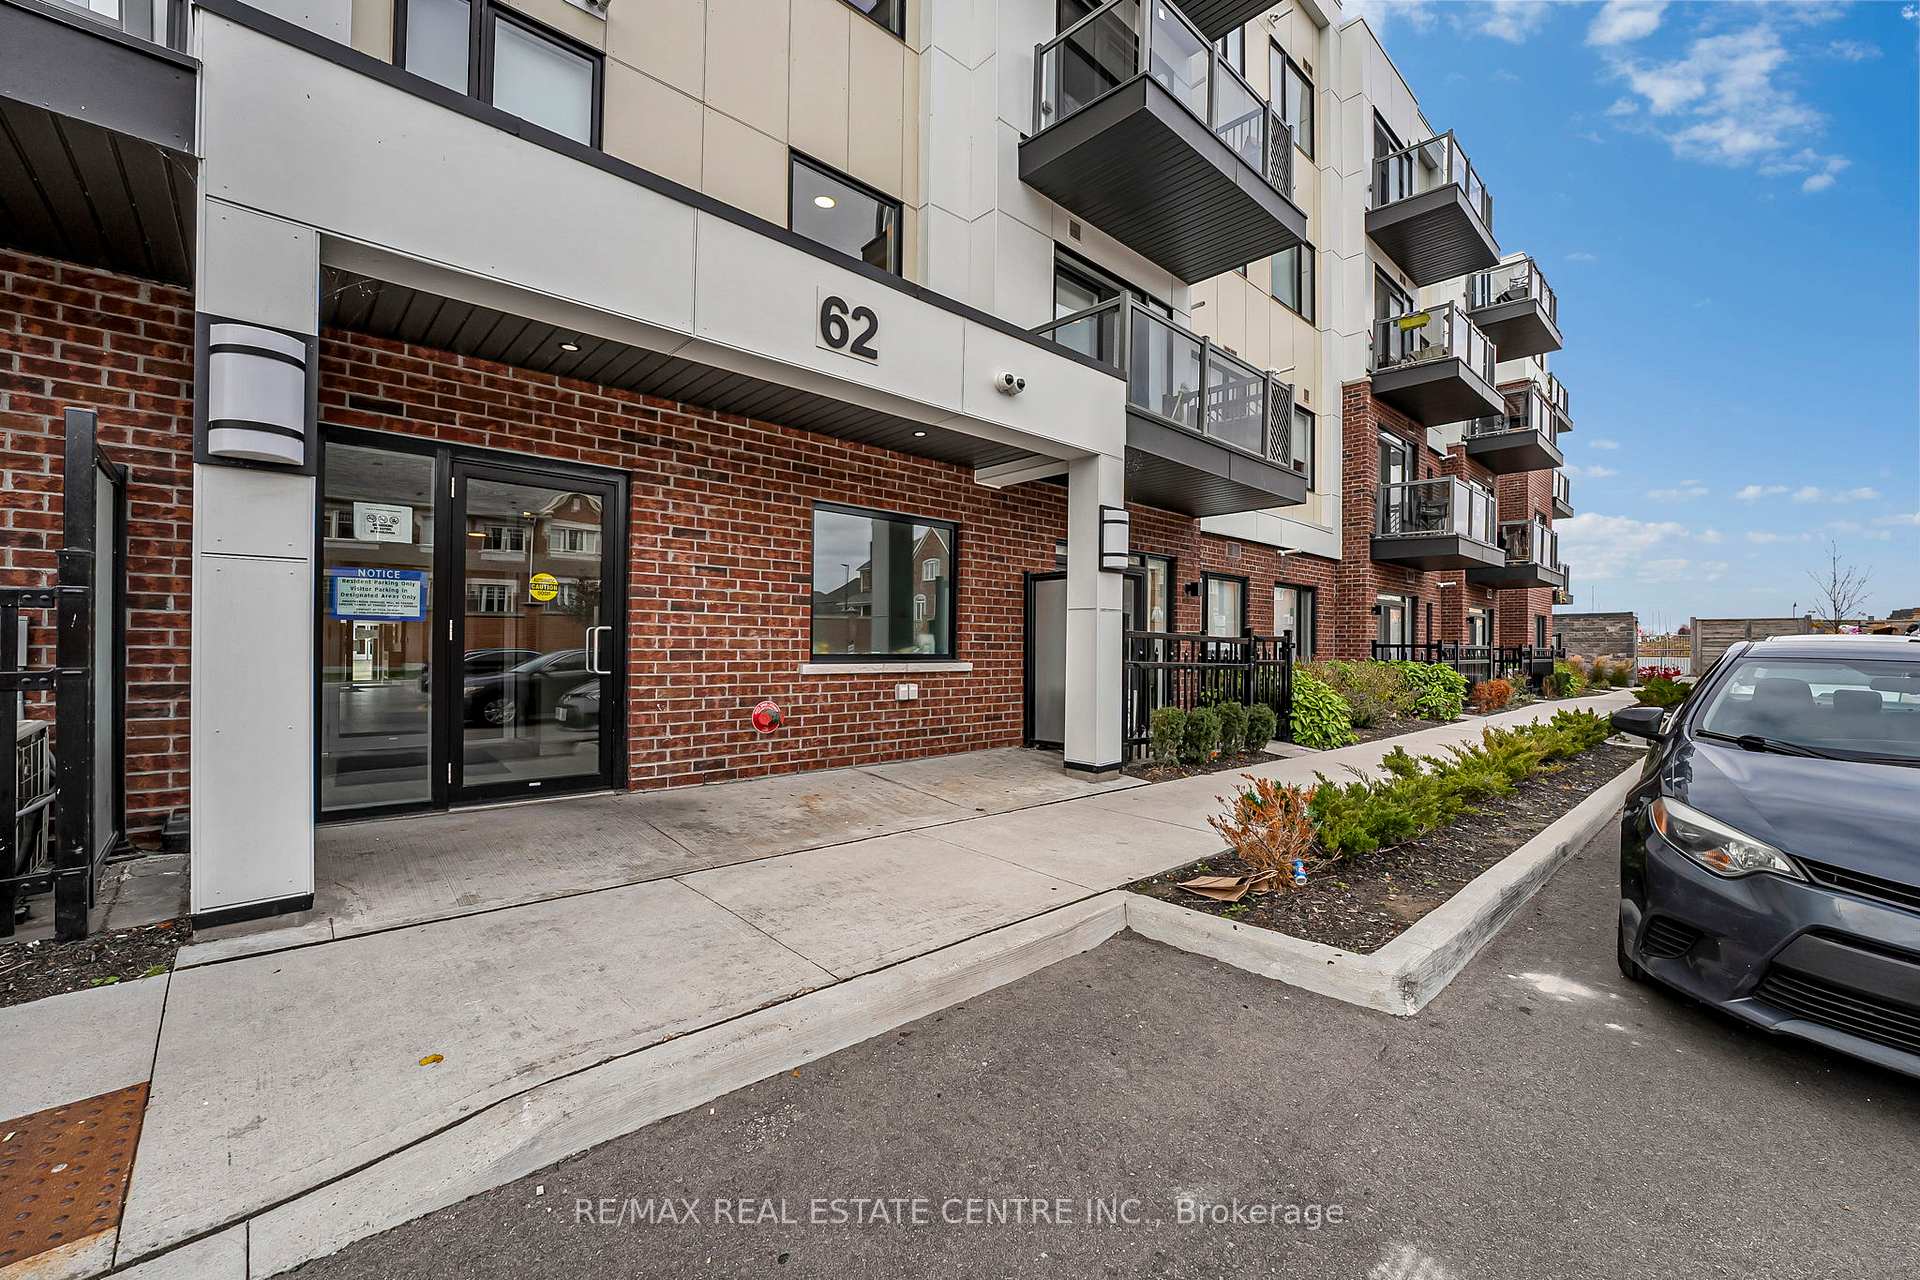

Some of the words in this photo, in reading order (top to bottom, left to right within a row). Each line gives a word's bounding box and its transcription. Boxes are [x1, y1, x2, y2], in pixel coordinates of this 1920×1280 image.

[821, 296, 878, 359] 62
[357, 568, 400, 579] NOTICE
[374, 579, 399, 587] Parking
[374, 586, 399, 594] Parking
[340, 591, 379, 599] Designated
[402, 593, 417, 601] Only
